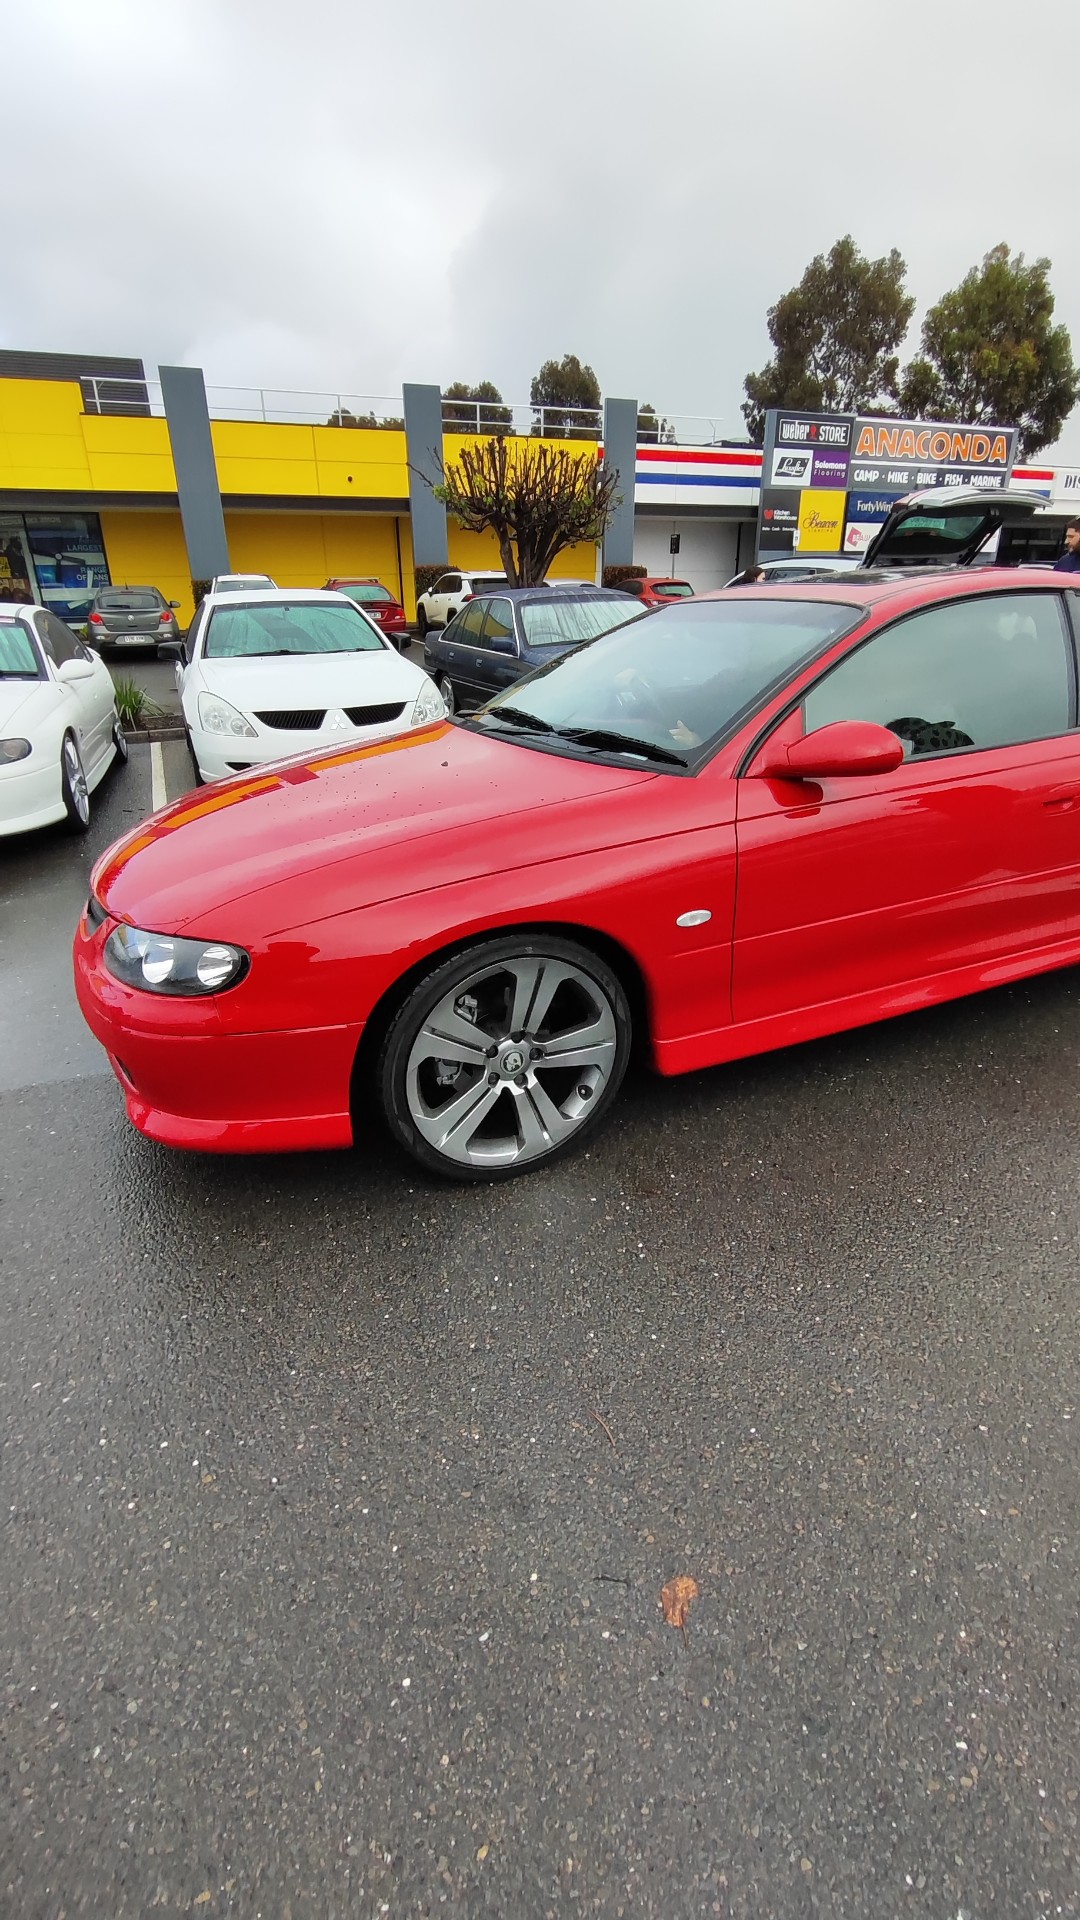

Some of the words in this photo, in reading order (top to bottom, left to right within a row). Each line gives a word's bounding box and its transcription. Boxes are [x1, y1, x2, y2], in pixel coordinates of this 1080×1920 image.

[782, 421, 809, 440] weber
[818, 426, 847, 443] STORE
[855, 426, 1006, 463] ANACONDA
[814, 460, 847, 470] Solomons
[814, 470, 846, 478] Flooring
[854, 469, 879, 482] CAMP
[887, 471, 909, 484] HIKE
[916, 472, 938, 485] BIKE
[944, 474, 963, 486] FISH
[969, 475, 1002, 487] MARINE
[802, 510, 839, 529] Beacon
[67, 544, 103, 552] LARGEST
